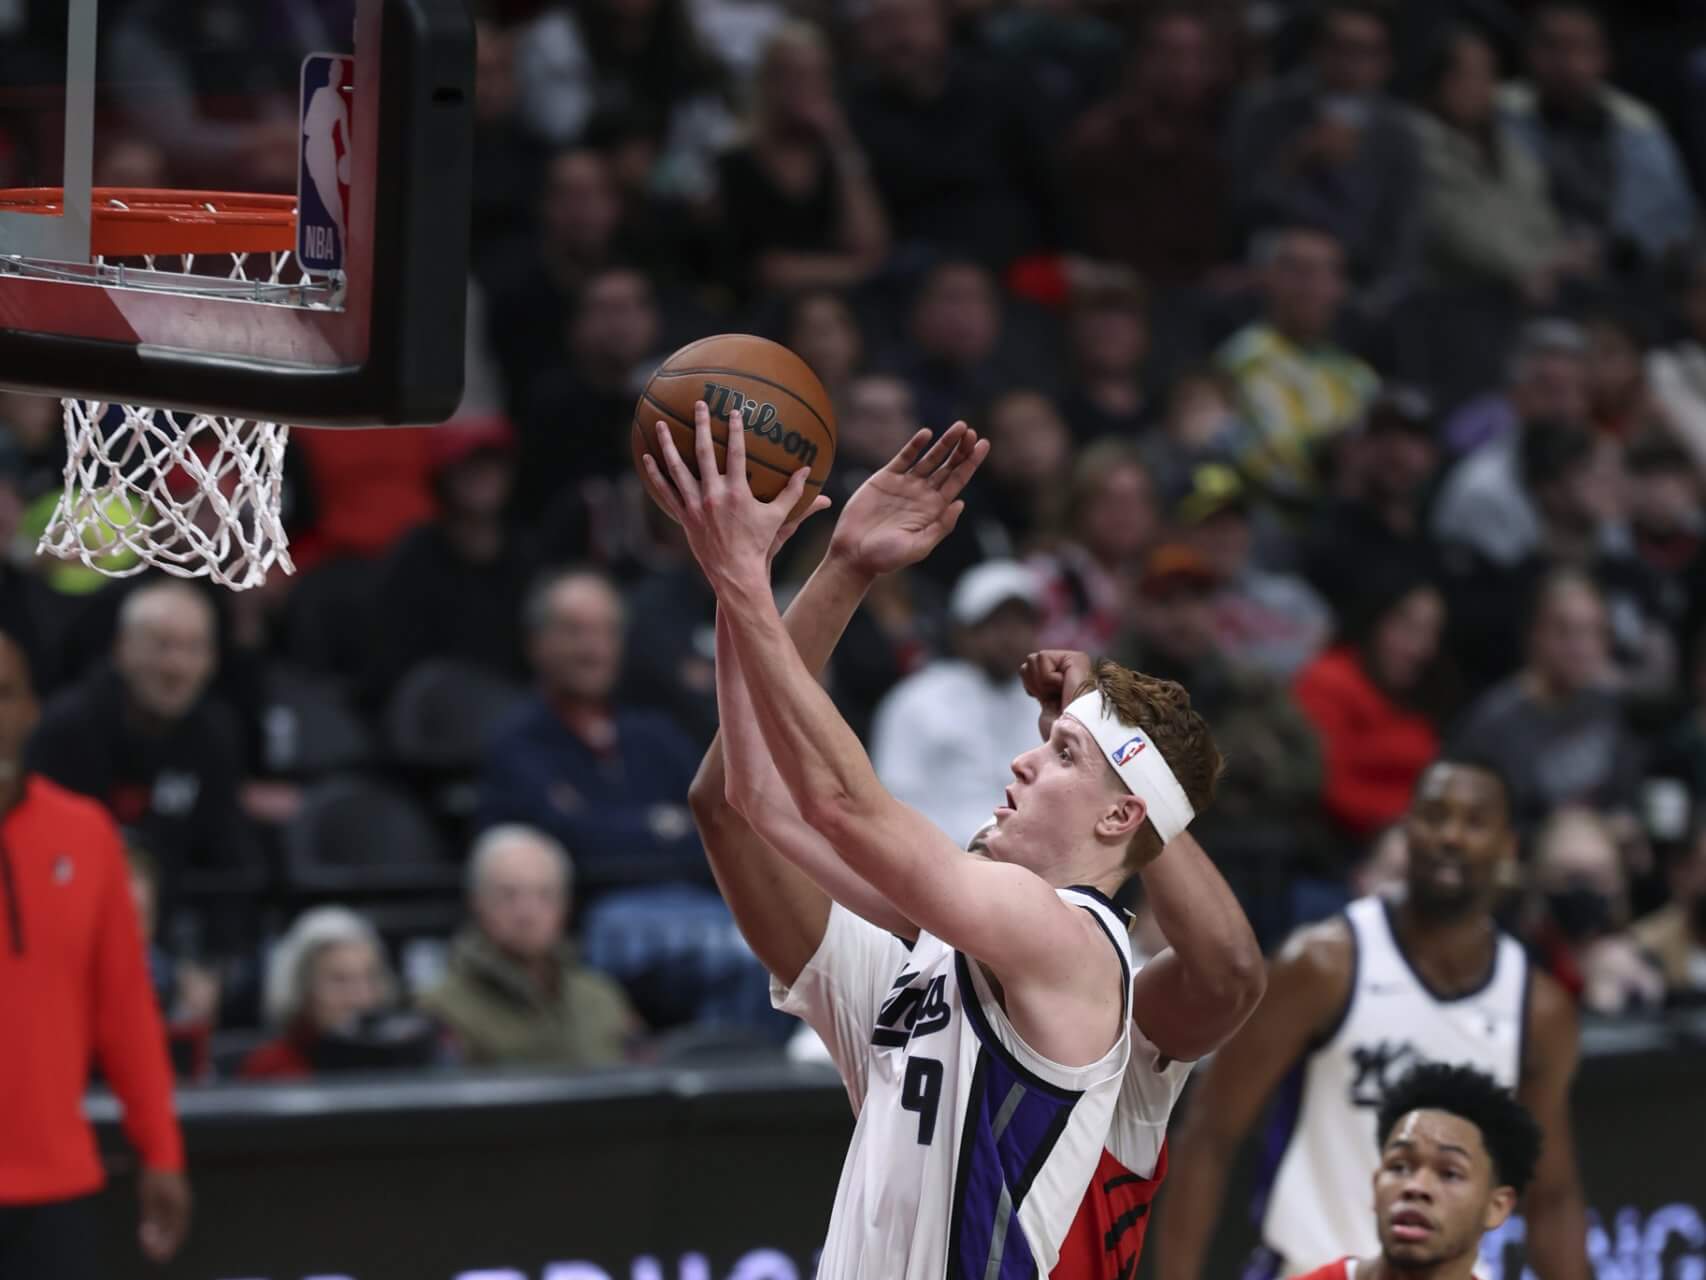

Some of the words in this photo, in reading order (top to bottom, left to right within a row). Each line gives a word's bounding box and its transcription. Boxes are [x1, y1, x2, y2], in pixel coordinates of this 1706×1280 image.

[305, 224, 335, 261] NBA
[703, 383, 818, 467] Wilson
[901, 1055, 944, 1146] 9
